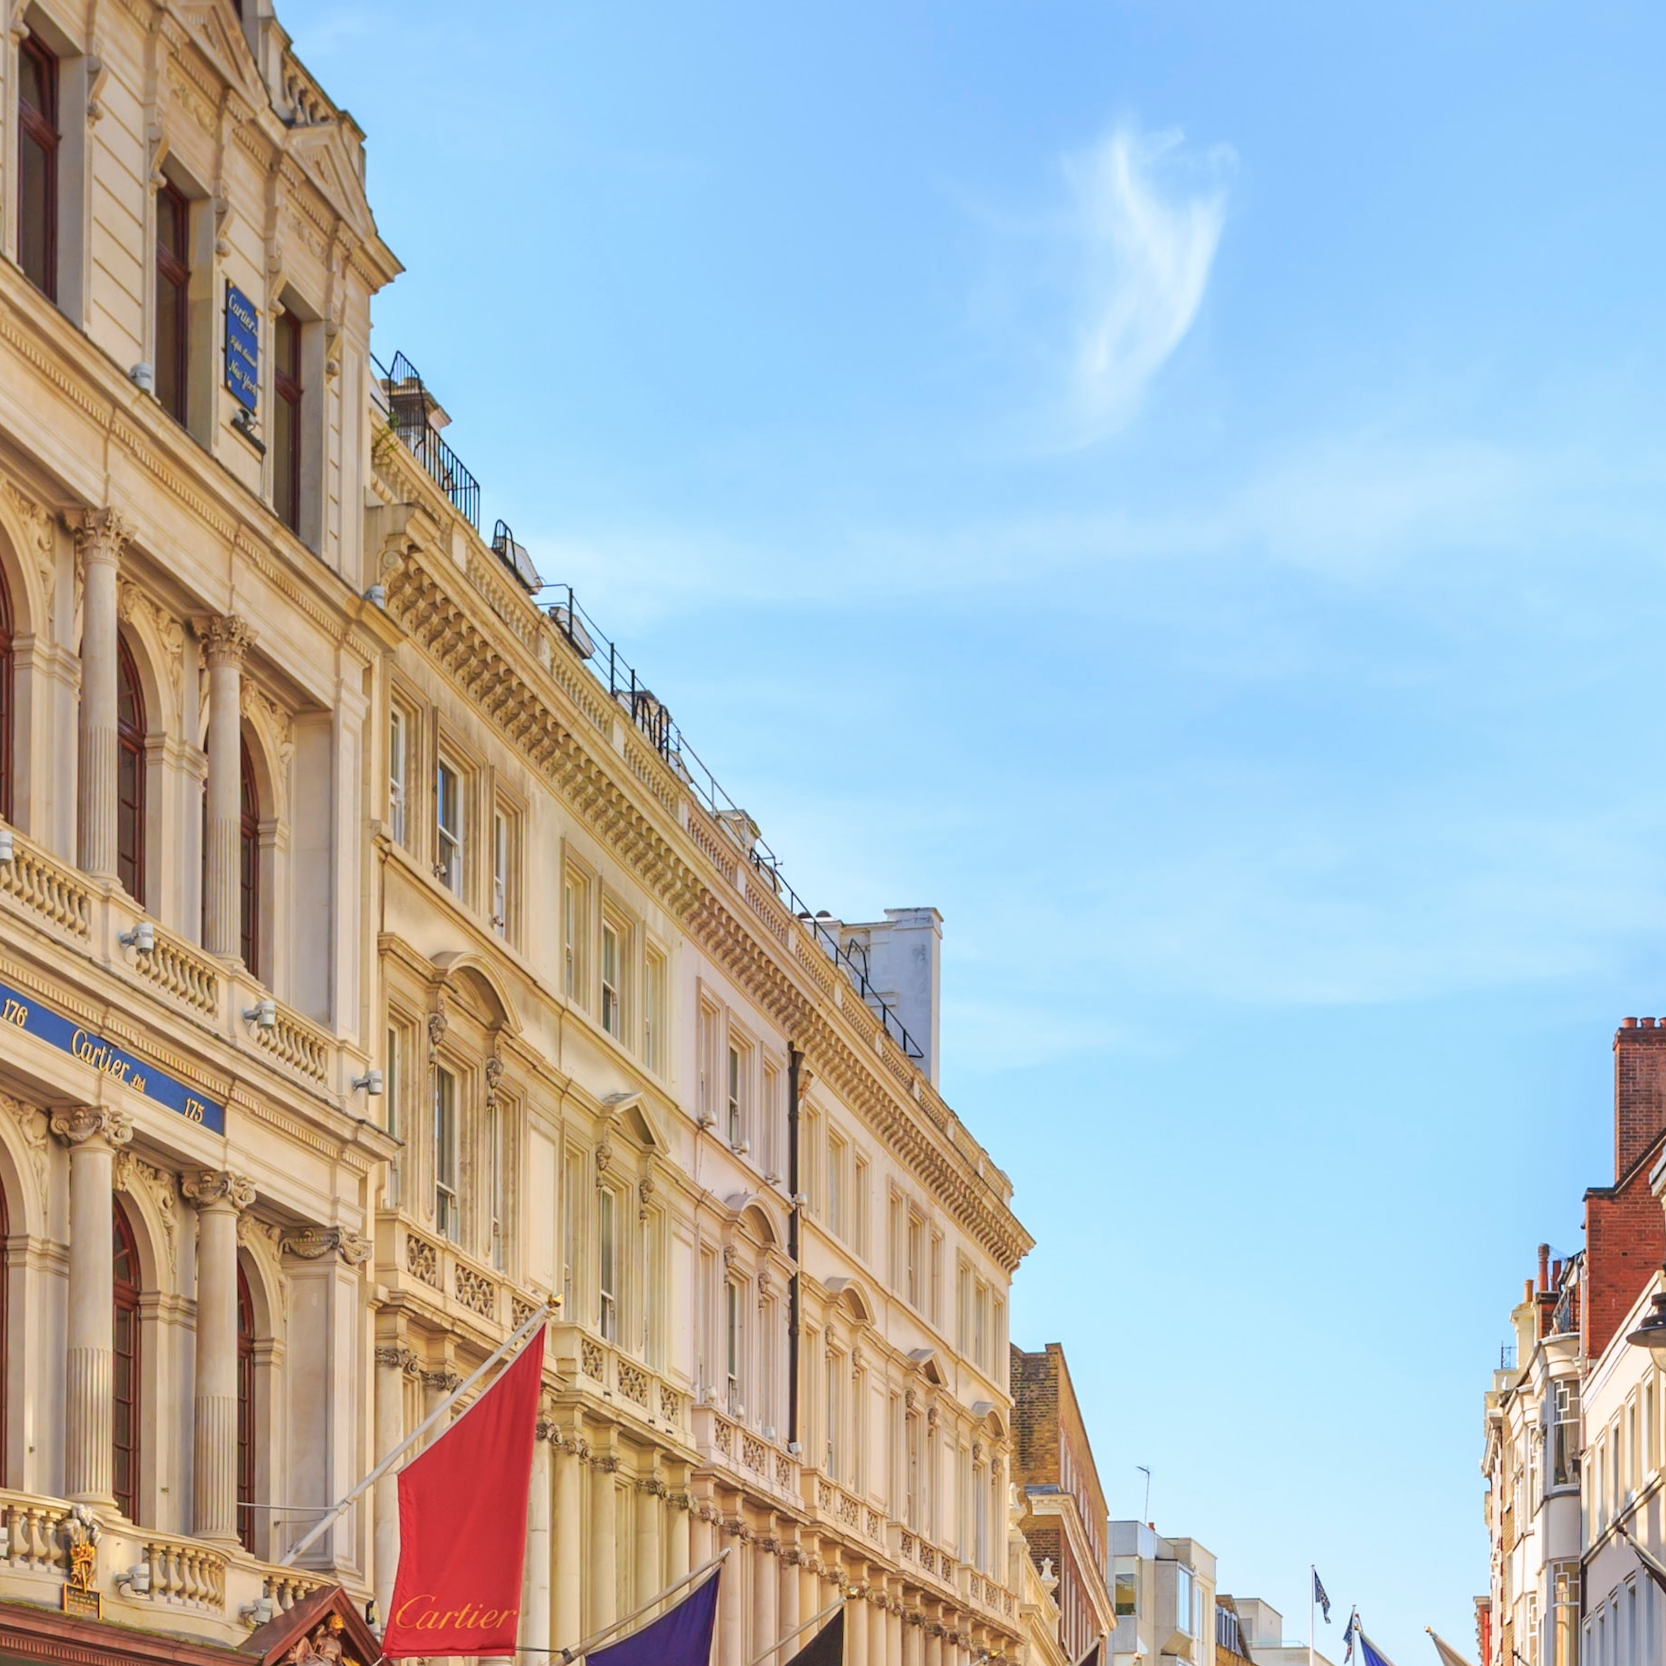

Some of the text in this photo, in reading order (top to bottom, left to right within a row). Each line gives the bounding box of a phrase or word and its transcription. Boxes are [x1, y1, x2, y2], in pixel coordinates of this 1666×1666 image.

[2, 998, 28, 1027] 176
[71, 1028, 130, 1084] Cartier
[185, 1098, 205, 1123] 175
[395, 1594, 517, 1631] Cartier
